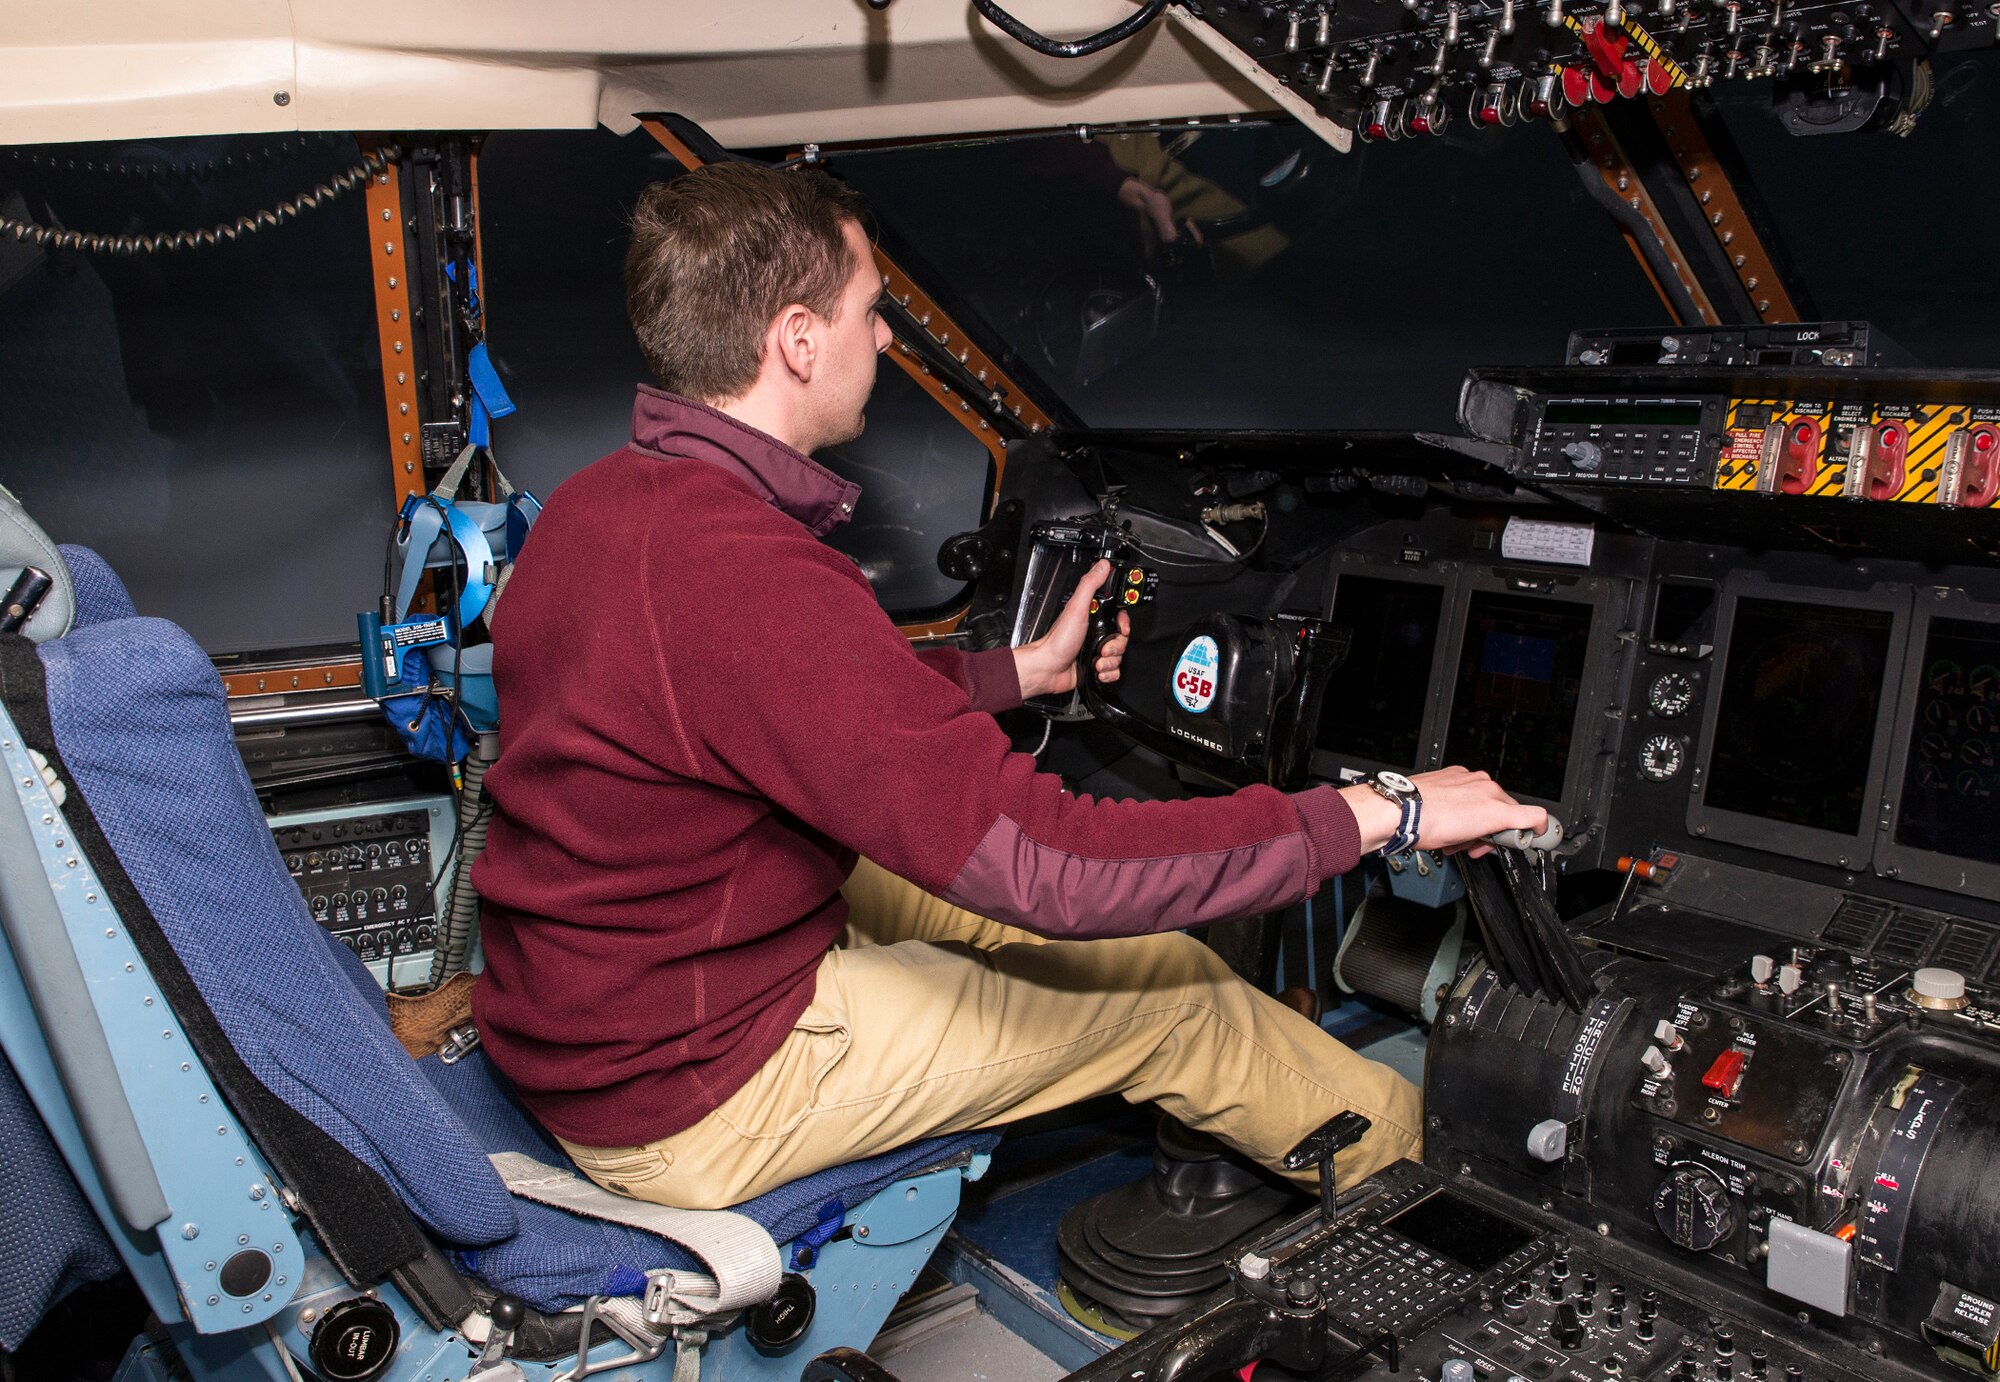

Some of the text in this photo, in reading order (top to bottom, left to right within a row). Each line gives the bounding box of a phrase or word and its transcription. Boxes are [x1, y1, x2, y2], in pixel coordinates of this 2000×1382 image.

[1797, 332, 1820, 341] LOCK
[1188, 666, 1205, 676] USAF
[1177, 672, 1212, 698] C-5B
[1171, 726, 1223, 751] LOCKHEED
[364, 921, 395, 930] EMERGENCY
[1678, 1002, 1699, 1012] RUDDER
[1676, 1013, 1690, 1021] NOSE
[1736, 1036, 1757, 1046] CASTER
[1563, 1017, 1597, 1092] THROTTLE
[1572, 1021, 1606, 1095] FRICTION
[1641, 1088, 1656, 1097] RIGHT
[1643, 1083, 1658, 1091] NOSE
[1708, 1097, 1729, 1108] CENTER
[1906, 1099, 1933, 1140] FLAPS
[1655, 1152, 1667, 1160] LEFT
[1655, 1157, 1667, 1166] WING
[1702, 1150, 1746, 1170] AILERON TRIM
[1731, 1187, 1744, 1196] WING
[1777, 1212, 1792, 1222] HAND
[1295, 1207, 1366, 1249] PITCH TRIM
[1962, 1294, 1994, 1310] GROUND
[775, 1304, 795, 1324] THIGH
[1958, 1301, 1991, 1318] SPOILER
[1954, 1307, 1989, 1326] RELEASE
[1487, 1326, 1500, 1335] YAW
[348, 1332, 360, 1357] IN-OUT
[357, 1331, 370, 1360] LUMBAR
[1512, 1339, 1531, 1351] PITCH
[1544, 1356, 1557, 1365] LAT
[1613, 1352, 1628, 1362] CALL
[1474, 1358, 1495, 1372] SPEED
[1570, 1369, 1592, 1382] ALDCS
